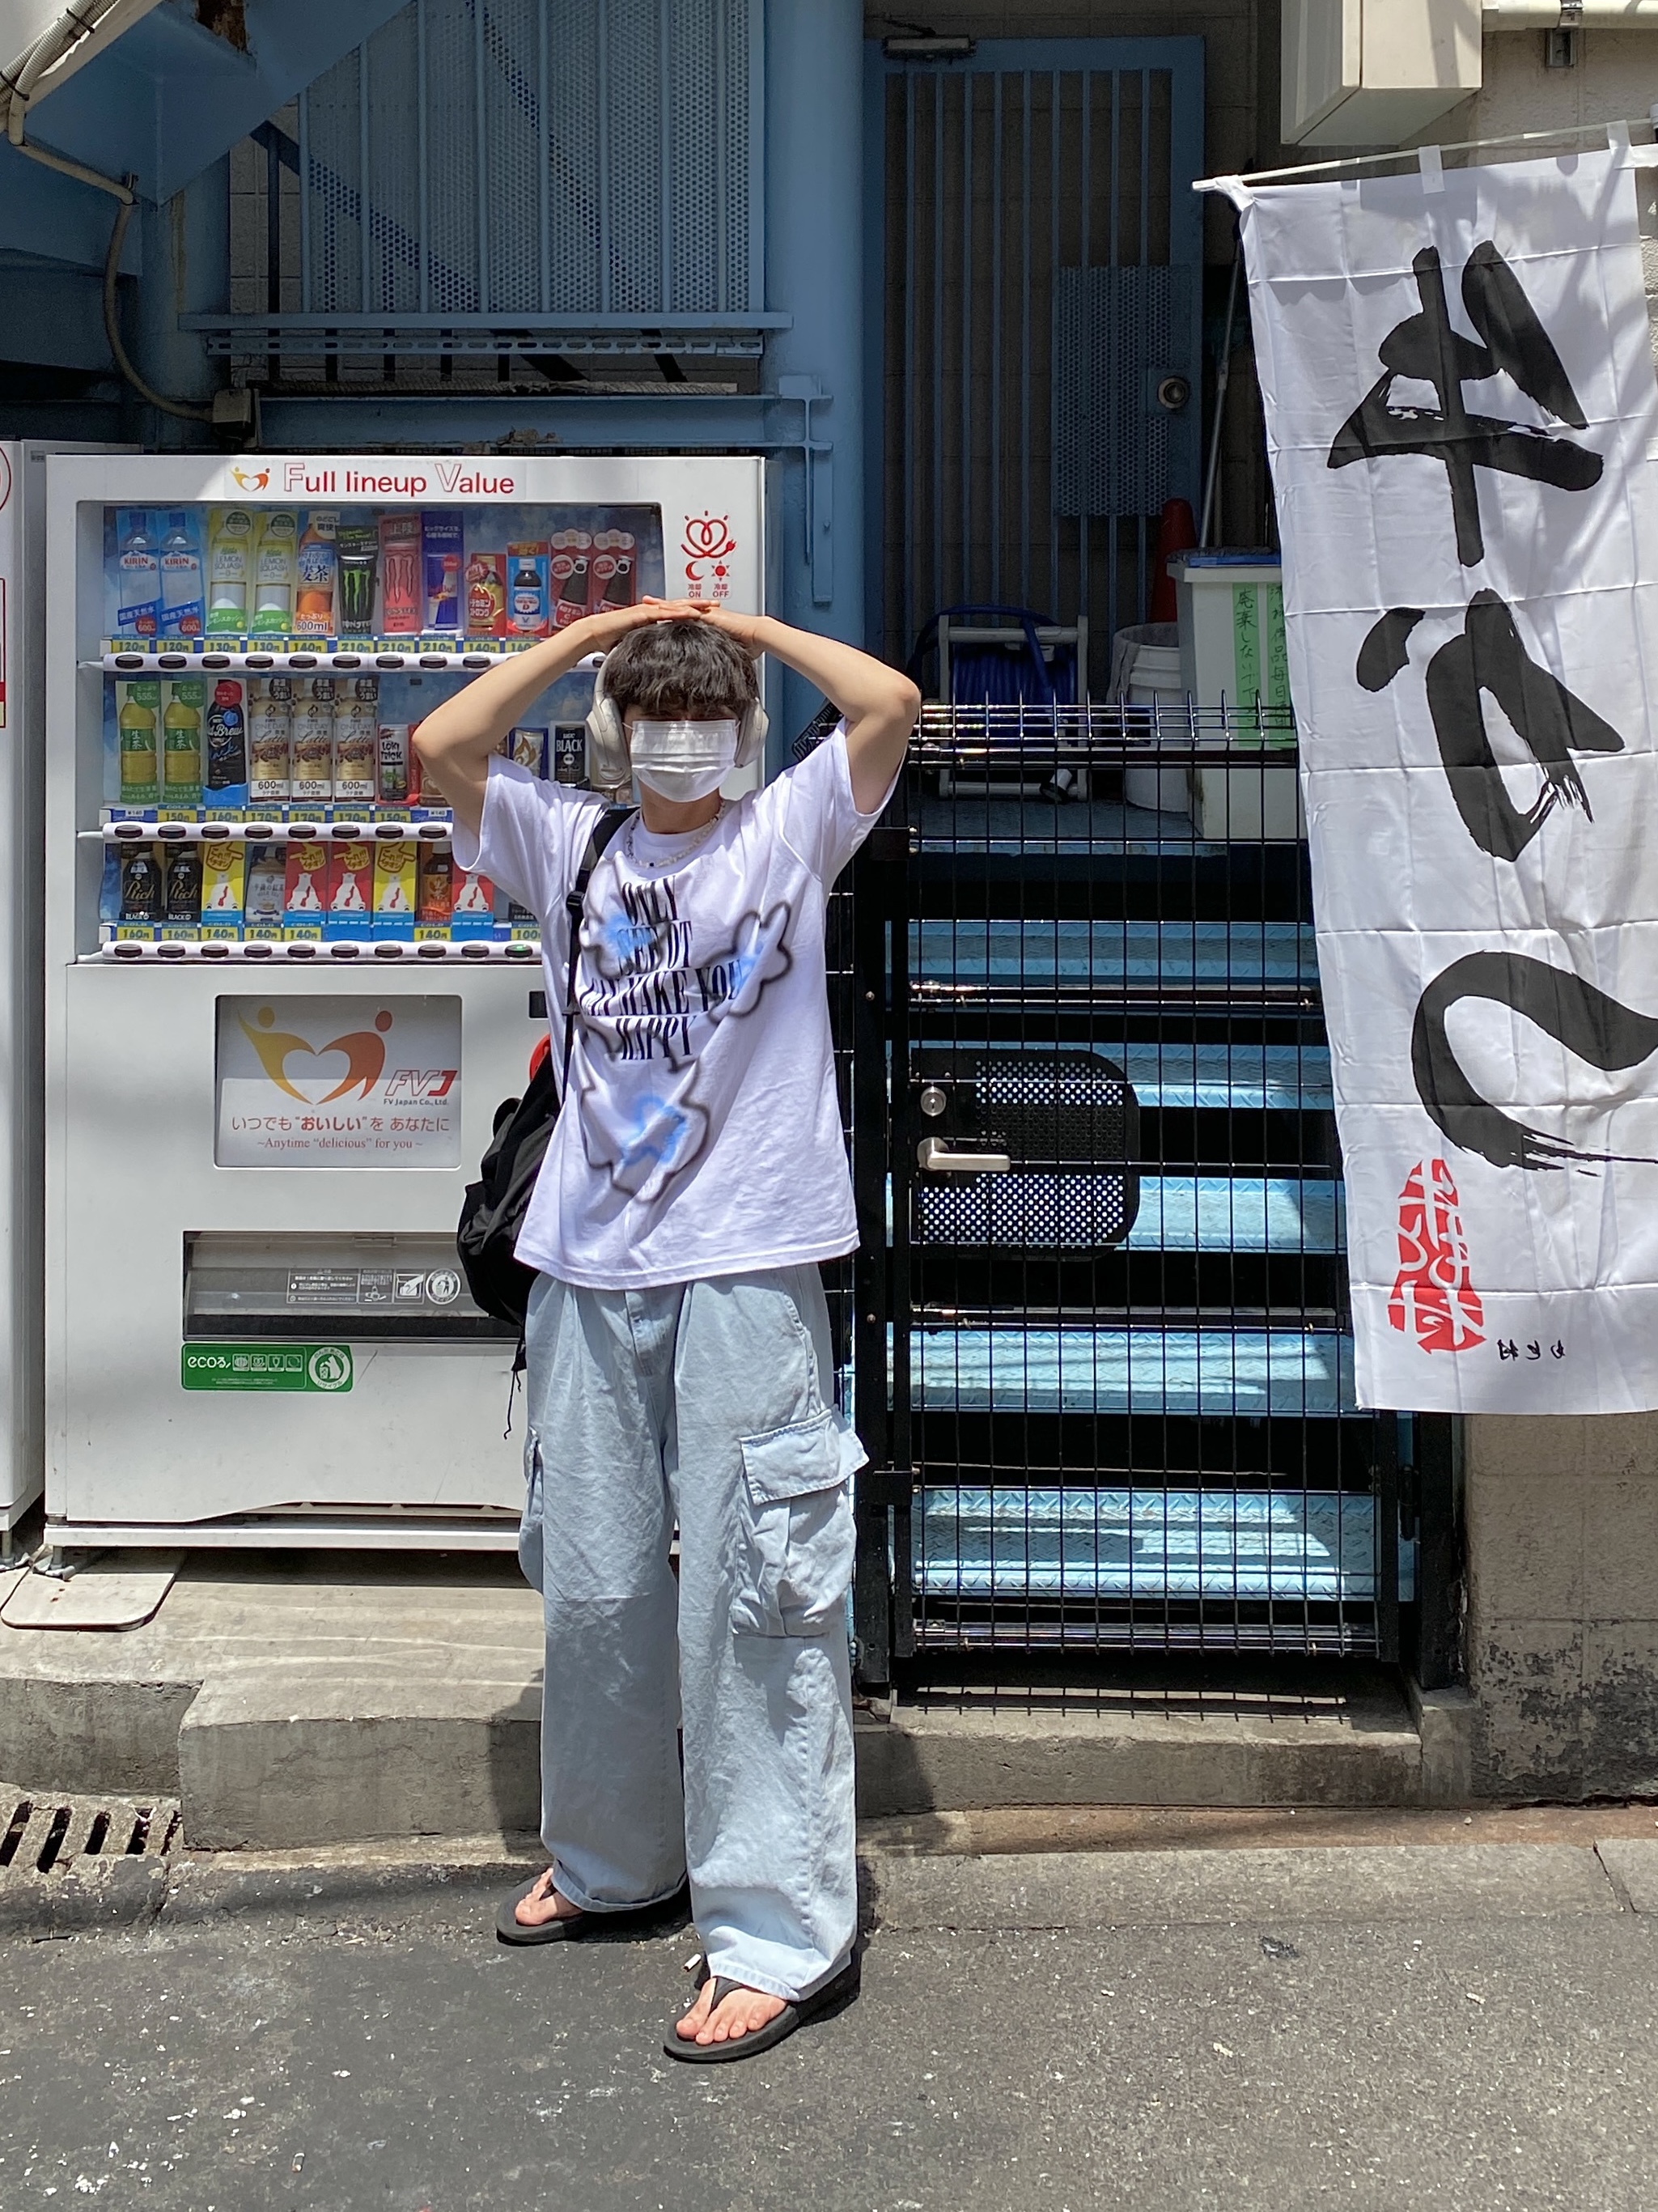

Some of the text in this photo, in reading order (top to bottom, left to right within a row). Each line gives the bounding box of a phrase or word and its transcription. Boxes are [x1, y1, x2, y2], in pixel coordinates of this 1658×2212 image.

[284, 463, 515, 497] Full lineup Value
[124, 557, 148, 565] KIRIN
[165, 557, 189, 566] KIRIN
[214, 562, 243, 570] SQUASH
[303, 565, 328, 582] 麦茶
[297, 621, 328, 631] 600ml
[118, 642, 145, 652] 120円
[163, 642, 189, 652] 120円
[210, 642, 235, 652] 130円
[253, 642, 279, 652] 130円
[294, 642, 321, 652] 140円
[341, 642, 370, 652] 210円
[381, 642, 410, 652] 210円
[422, 642, 452, 652] 210円
[469, 642, 496, 652] 140円
[131, 730, 142, 749] 生茶
[176, 730, 187, 749] 生茶
[556, 739, 583, 752] BLACK
[166, 813, 190, 822] 150円
[212, 813, 239, 822] 160円
[380, 813, 407, 822] 150円
[125, 880, 155, 899] Rich
[169, 880, 198, 899] Rich
[123, 929, 150, 940] 160円
[167, 929, 194, 940] 160円
[206, 929, 234, 940] 140円
[249, 929, 277, 940] 140円
[290, 929, 317, 940] 140円
[419, 929, 447, 940] 140円
[621, 970, 690, 1016] MAKE
[694, 959, 742, 1013] YOU
[616, 1014, 697, 1060] HAPPY
[396, 1098, 418, 1107] Japan
[389, 1115, 449, 1131] あなたに
[375, 1137, 390, 1148] for
[393, 1140, 413, 1149] you
